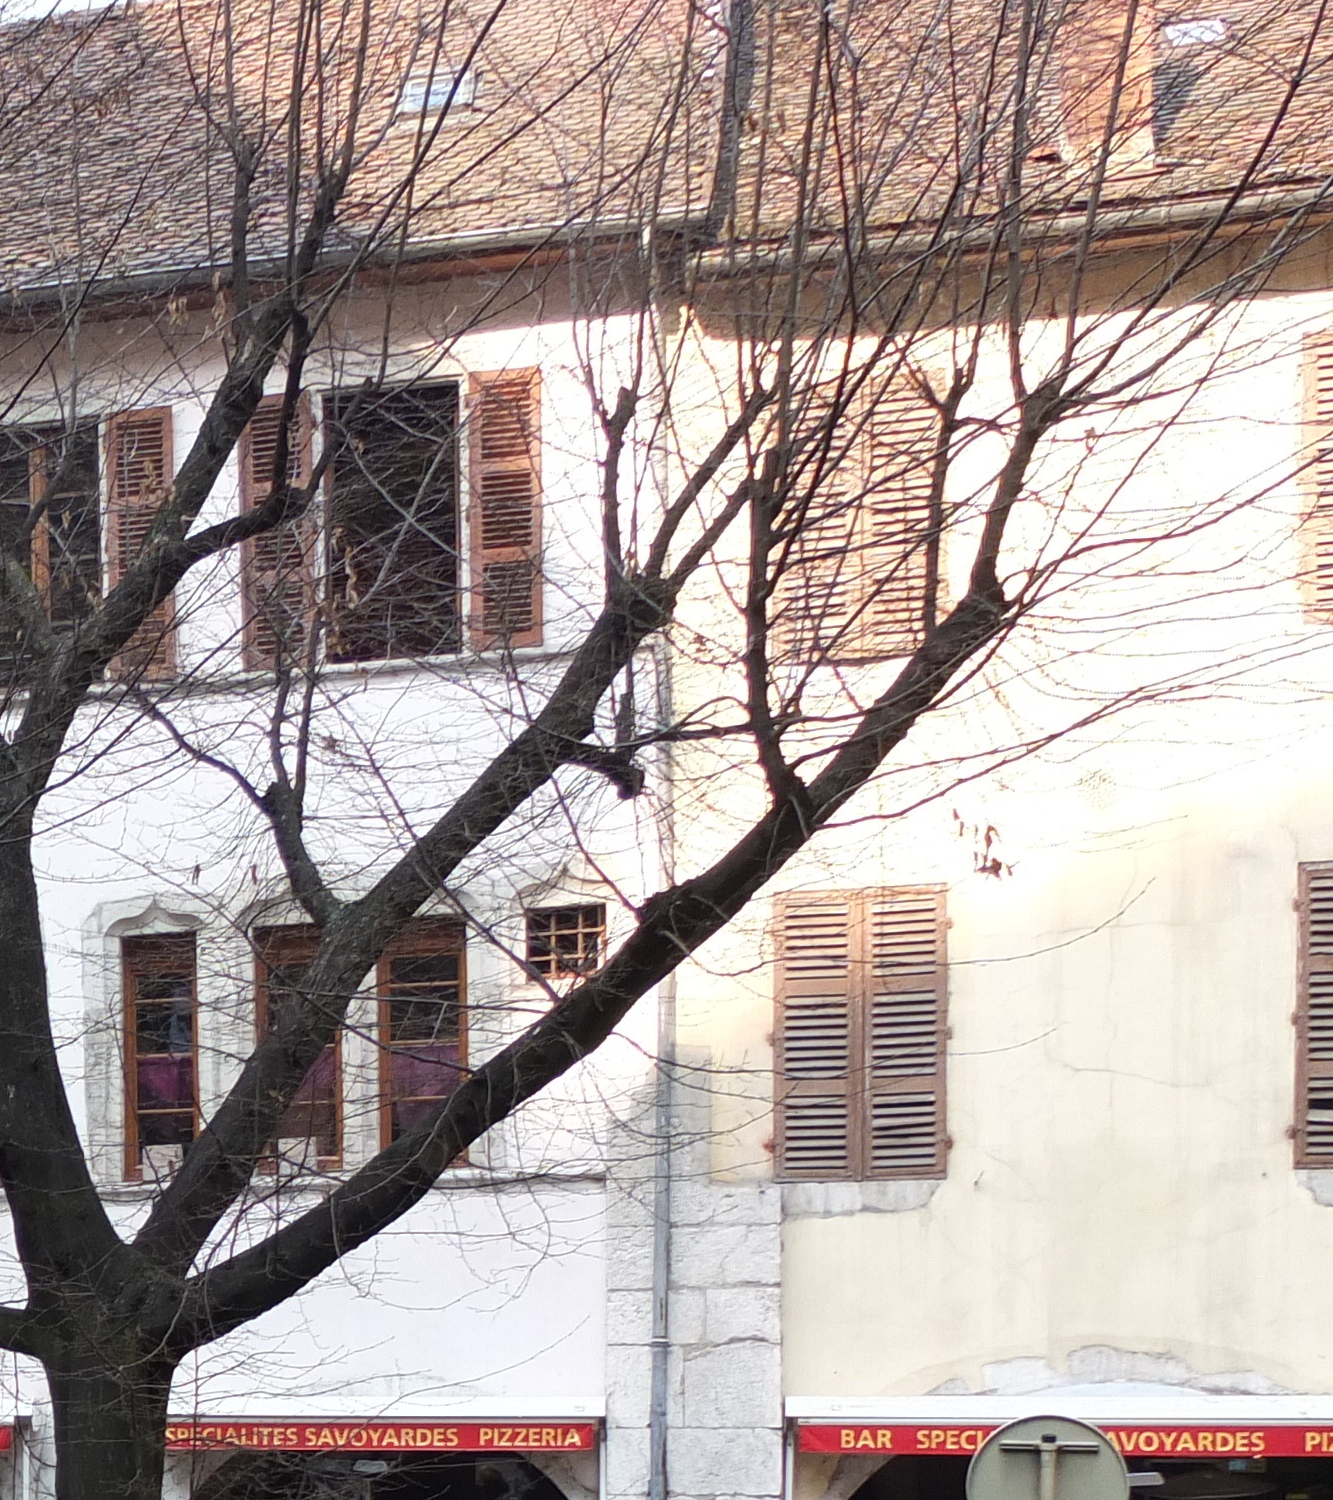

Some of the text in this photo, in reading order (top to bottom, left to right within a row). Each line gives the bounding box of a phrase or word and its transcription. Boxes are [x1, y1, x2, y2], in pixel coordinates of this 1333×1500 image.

[305, 1427, 459, 1447] SAVOYARDES
[479, 1427, 582, 1447] PIZZERIA
[840, 1429, 892, 1449] BAR
